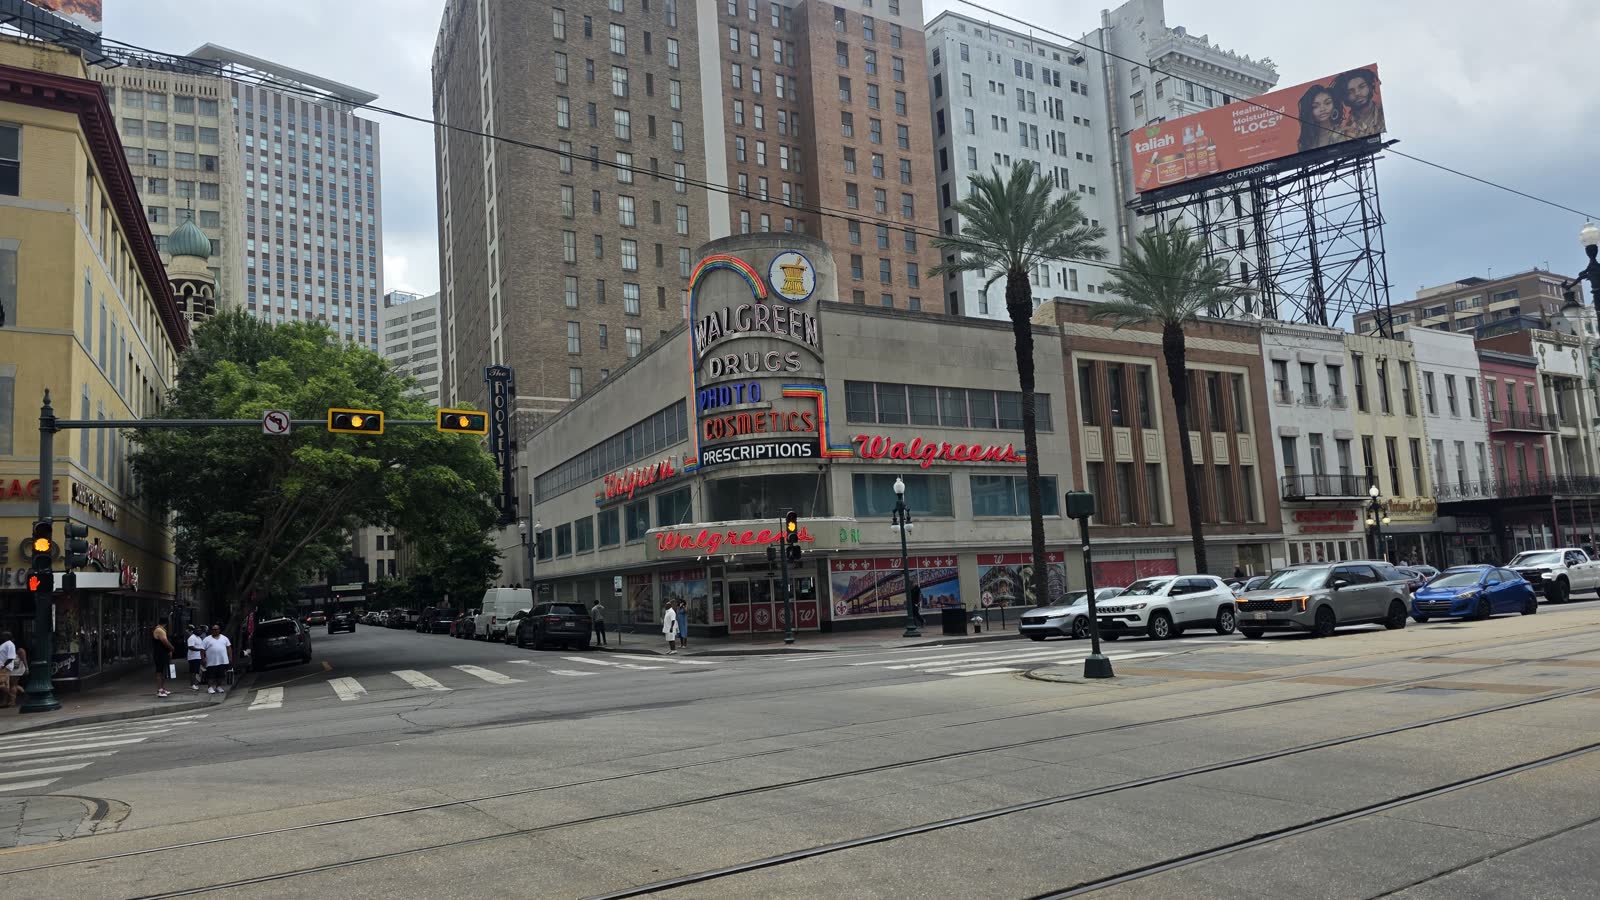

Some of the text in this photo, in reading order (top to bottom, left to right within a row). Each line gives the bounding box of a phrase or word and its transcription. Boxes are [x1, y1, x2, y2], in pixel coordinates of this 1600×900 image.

[1233, 106, 1285, 126] Moisturized
[1135, 133, 1175, 153] taliah
[1226, 163, 1271, 180] OUTFRONT
[694, 303, 819, 355] WALGREEN
[489, 368, 506, 377] The
[709, 351, 801, 378] DRUGS
[699, 382, 762, 411] PHOTO
[703, 411, 815, 440] COSMETICS
[703, 443, 812, 466] PRESCRIPTIONS
[852, 434, 1022, 469] Walgreens
[655, 525, 815, 554] Walgreens
